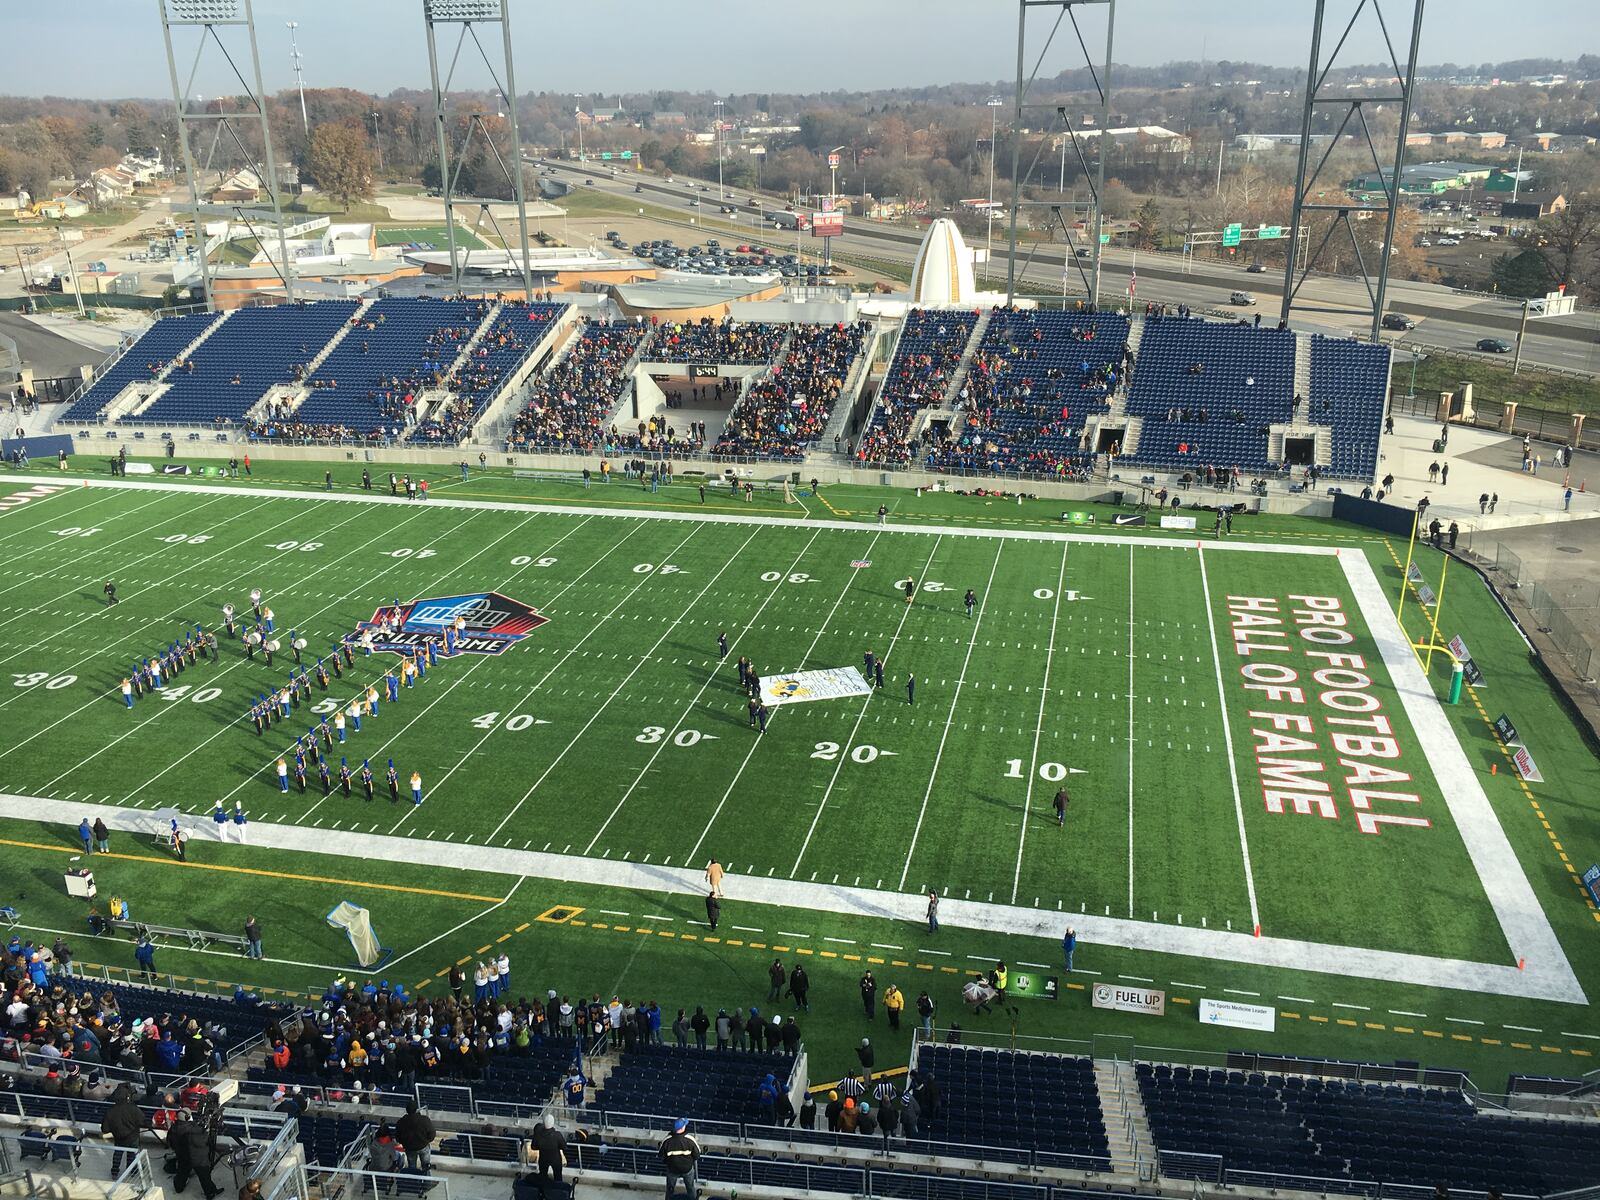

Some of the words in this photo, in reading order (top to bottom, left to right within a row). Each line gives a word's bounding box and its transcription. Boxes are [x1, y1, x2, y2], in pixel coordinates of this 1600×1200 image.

[696, 367, 717, 376] 6:44
[276, 540, 324, 551] 30
[391, 548, 438, 559] 40
[510, 555, 559, 567] 50
[632, 563, 681, 575] 40
[760, 571, 811, 584] 30
[1033, 588, 1081, 600] 10
[1226, 595, 1292, 656] HALL
[1288, 594, 1355, 645] PRO
[13, 672, 78, 689] 30
[1240, 662, 1306, 704] OF
[160, 685, 223, 703] 40
[470, 711, 535, 731] 40
[635, 726, 702, 747] 30
[1305, 650, 1432, 834] FOOTBALL
[809, 741, 879, 763] 20
[1003, 758, 1068, 782] 10
[1248, 709, 1339, 819] FAME
[1515, 747, 1531, 776] Wilson
[1116, 990, 1142, 1004] FUEL
[1145, 994, 1160, 1005] UP
[1231, 1004, 1252, 1012] Medicine
